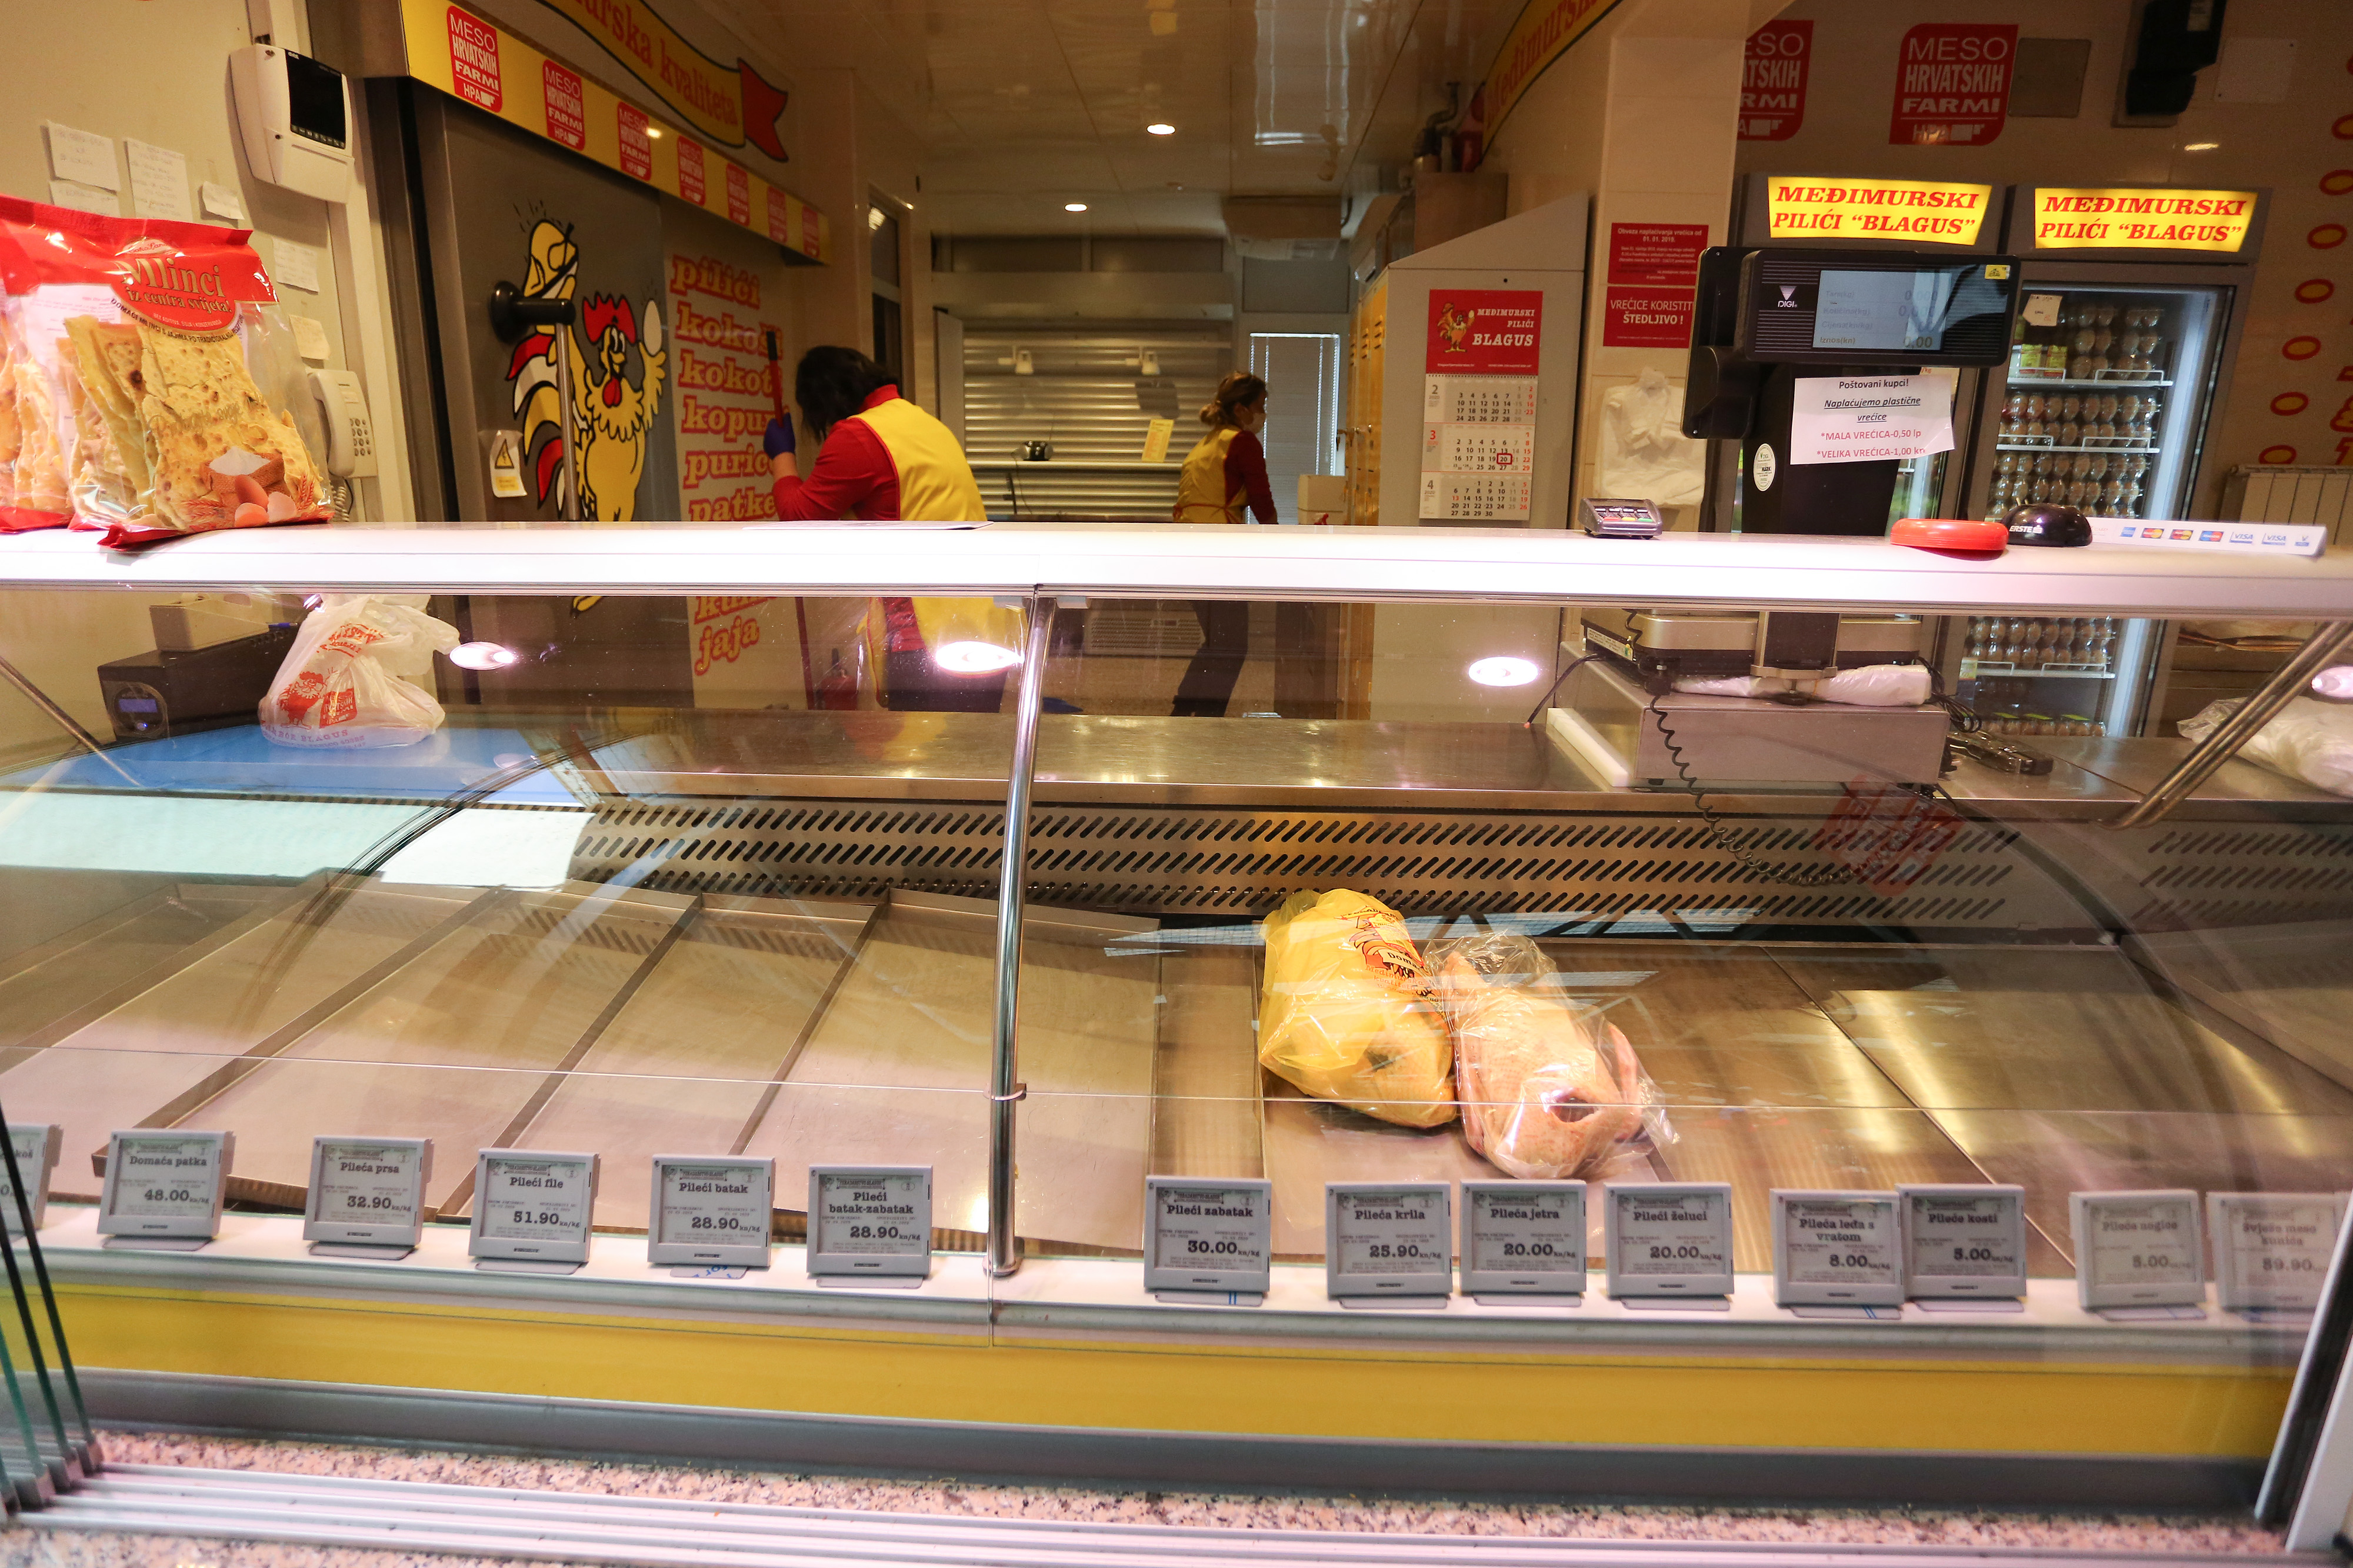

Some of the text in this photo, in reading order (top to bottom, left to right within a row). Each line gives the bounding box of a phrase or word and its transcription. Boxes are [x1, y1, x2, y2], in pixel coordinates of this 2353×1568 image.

[450, 14, 495, 52] MESO
[452, 34, 498, 76] HRVATSKIH
[1908, 36, 2008, 61] MESO
[455, 59, 499, 91] FARMI
[1904, 63, 2005, 94] HRVATSKIH
[545, 66, 581, 98] MESO
[463, 83, 482, 102] HPA
[1901, 96, 2000, 114] FARMI
[548, 107, 583, 132] FARMI
[1775, 186, 1979, 209] MEĐIMURSKI
[2042, 196, 2247, 216] MEĐIMURSKI
[1772, 209, 1844, 229] PILIĆI
[2038, 218, 2110, 239] PILIĆI
[113, 256, 226, 298] Mlinci
[669, 253, 761, 309] pilići
[125, 286, 233, 314] iz centra svijeta!
[1610, 297, 1694, 311] VREĆICE KORISTIT
[111, 298, 139, 321] DOMAĆI
[1507, 319, 1534, 328] PILIĆI
[1623, 311, 1678, 324] ŠTEDLJIVO
[1472, 333, 1534, 346] BLAGUS
[1432, 384, 1438, 395] 2
[1839, 378, 1909, 389] Poštovani kupci!
[1824, 396, 1921, 408] Naplaćujemo plastične
[1857, 413, 1887, 422] vrećice
[1429, 430, 1436, 440] 3
[1853, 429, 1911, 439] VREĆICA-0,50
[1853, 447, 1911, 457] VREĆICA-1,00
[1427, 480, 1434, 489] 4
[694, 615, 760, 676] jaja
[129, 1155, 208, 1167] Domaća patka
[340, 1160, 400, 1175] Pileća prsa
[509, 1176, 564, 1189] Pileći file
[679, 1182, 748, 1194] Pileći batak
[144, 1189, 189, 1201] 48.00
[347, 1195, 391, 1208] 32.90
[853, 1192, 887, 1202] Pileći
[829, 1203, 914, 1215] batak-zabatak
[1166, 1205, 1253, 1217] Pileći zabatak
[1354, 1209, 1425, 1220] Pileća krila
[1490, 1208, 1559, 1222] Pileća jetra
[514, 1211, 559, 1225] 51.90
[1632, 1210, 1708, 1222] Pileći želuci
[1967, 1213, 1998, 1224] kosti
[691, 1216, 761, 1233] 28.90 kn/kg
[1799, 1218, 1837, 1230] Pileća
[850, 1226, 899, 1239] 28.90
[1815, 1232, 1861, 1243] vratom
[1187, 1240, 1237, 1254] 30.00
[1369, 1245, 1418, 1259] 25.90
[1504, 1243, 1553, 1256] 20.00
[1649, 1246, 1699, 1259] 20.00
[1828, 1253, 1868, 1267] 8.00
[1953, 1247, 1991, 1261] 5.00
